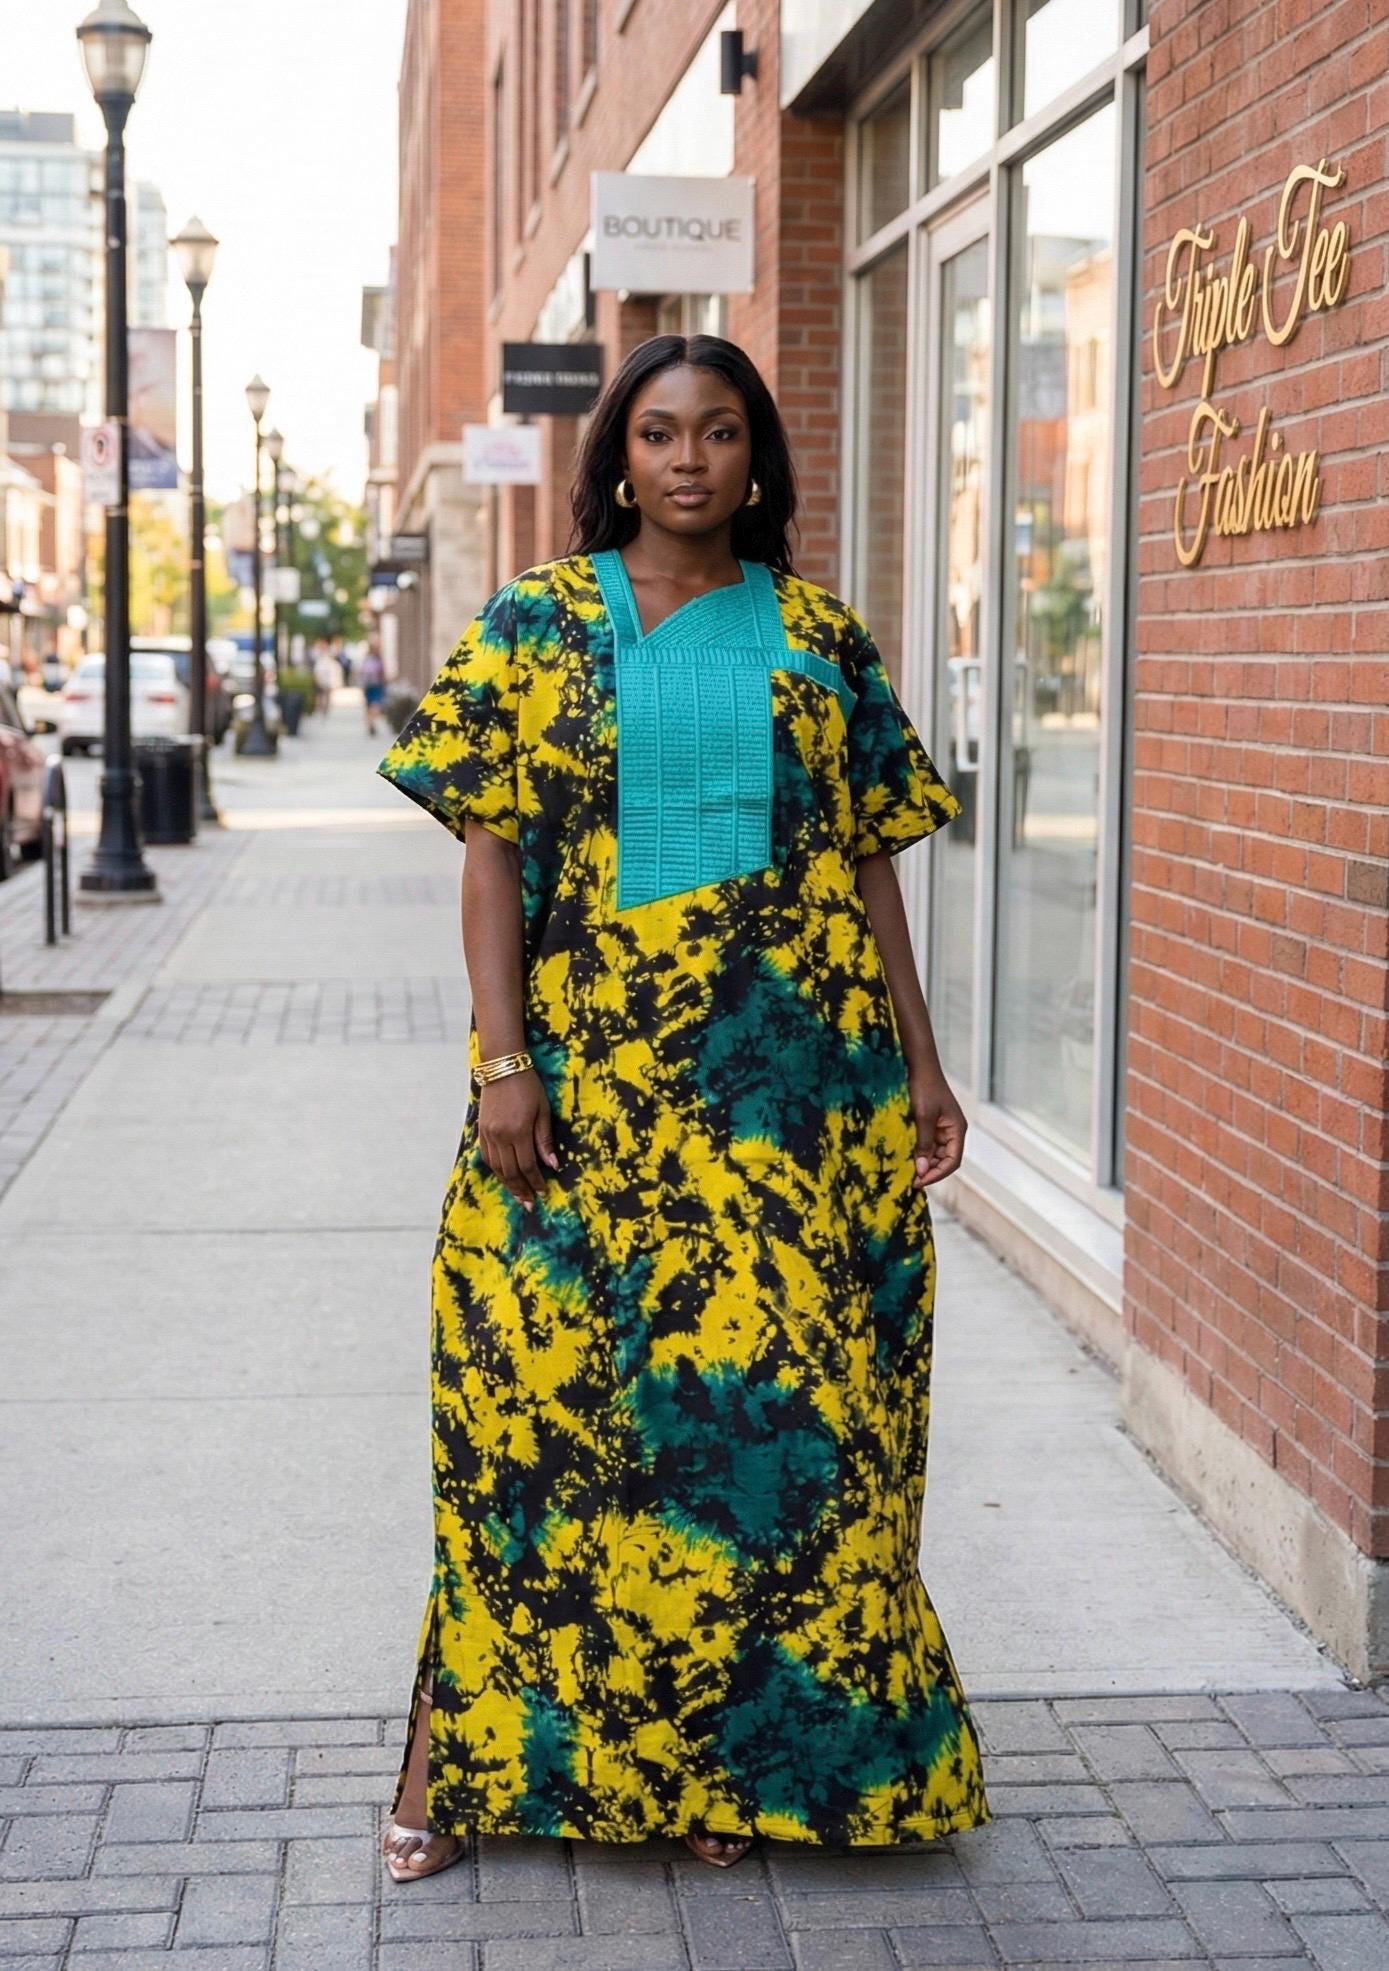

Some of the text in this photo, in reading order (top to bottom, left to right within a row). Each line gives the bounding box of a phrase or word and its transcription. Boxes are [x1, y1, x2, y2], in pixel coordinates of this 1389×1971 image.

[603, 215, 743, 241] BOUTIQUE
[1153, 158, 1346, 398] Triple Tee
[1174, 401, 1320, 567] Fashion
